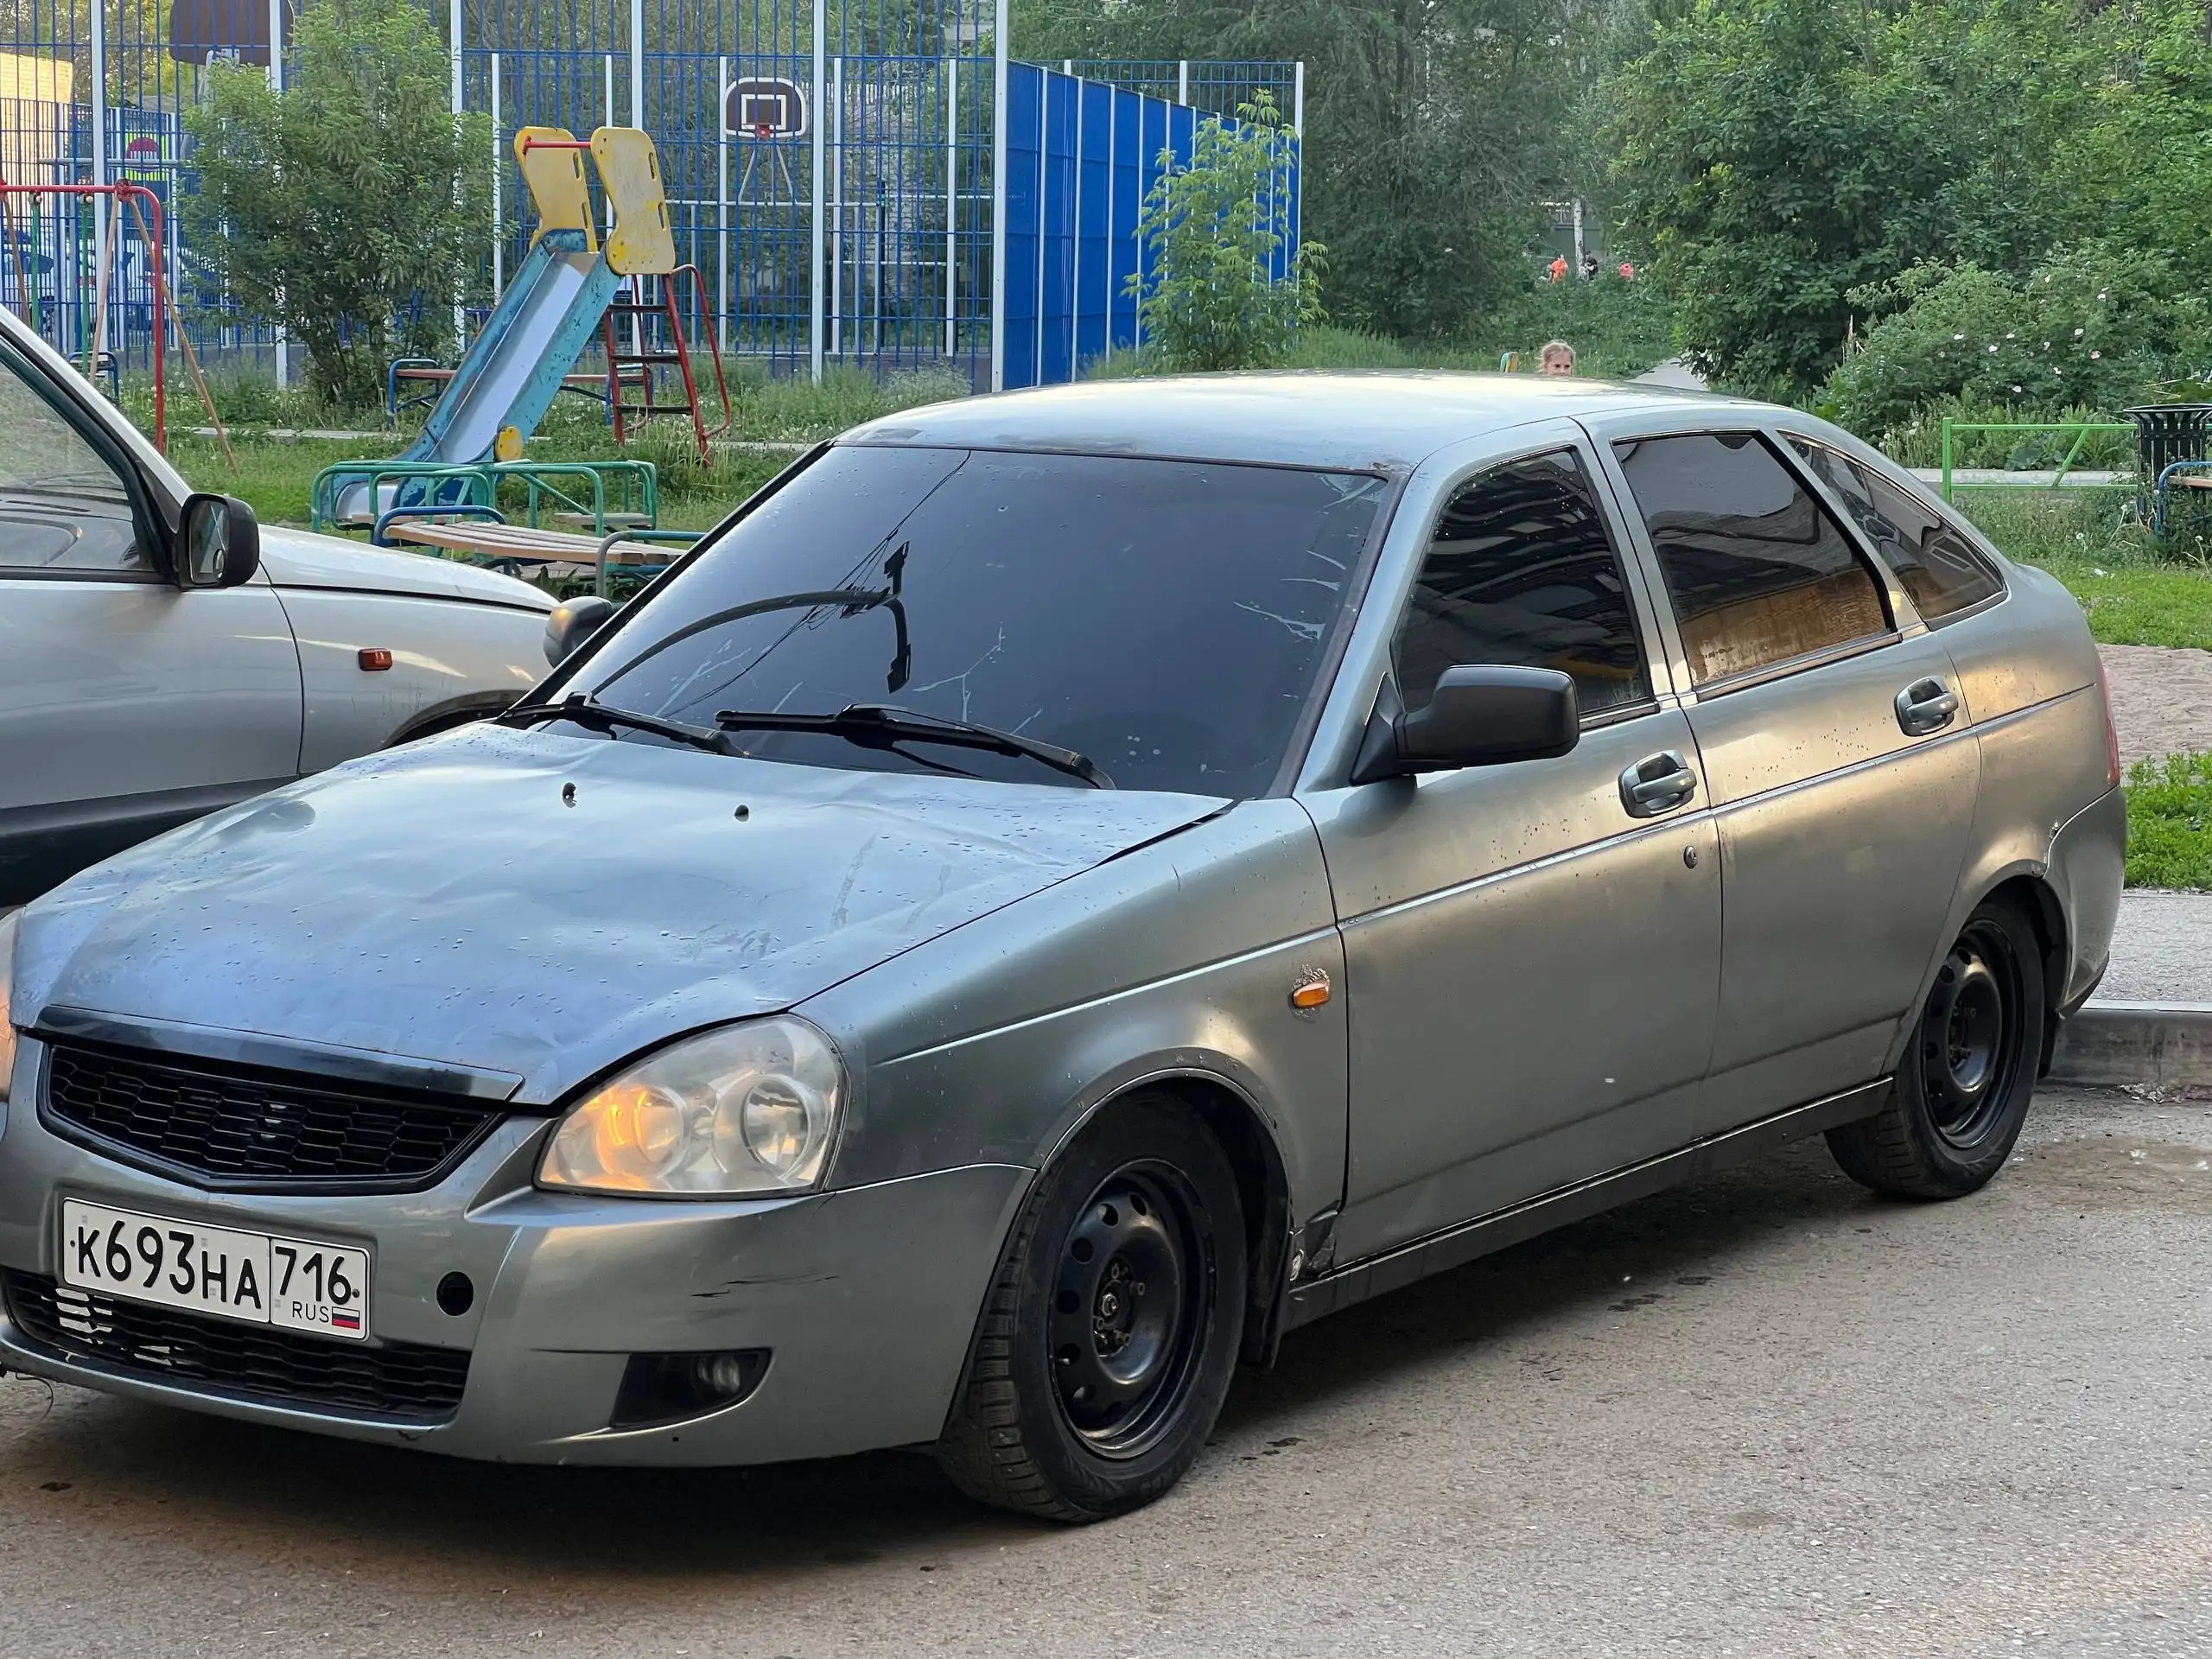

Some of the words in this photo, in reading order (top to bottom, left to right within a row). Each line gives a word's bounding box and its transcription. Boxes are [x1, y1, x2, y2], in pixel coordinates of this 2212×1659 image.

[78, 1220, 262, 1309] К693НА
[275, 1246, 352, 1305] 716
[291, 1301, 329, 1323] RUS
